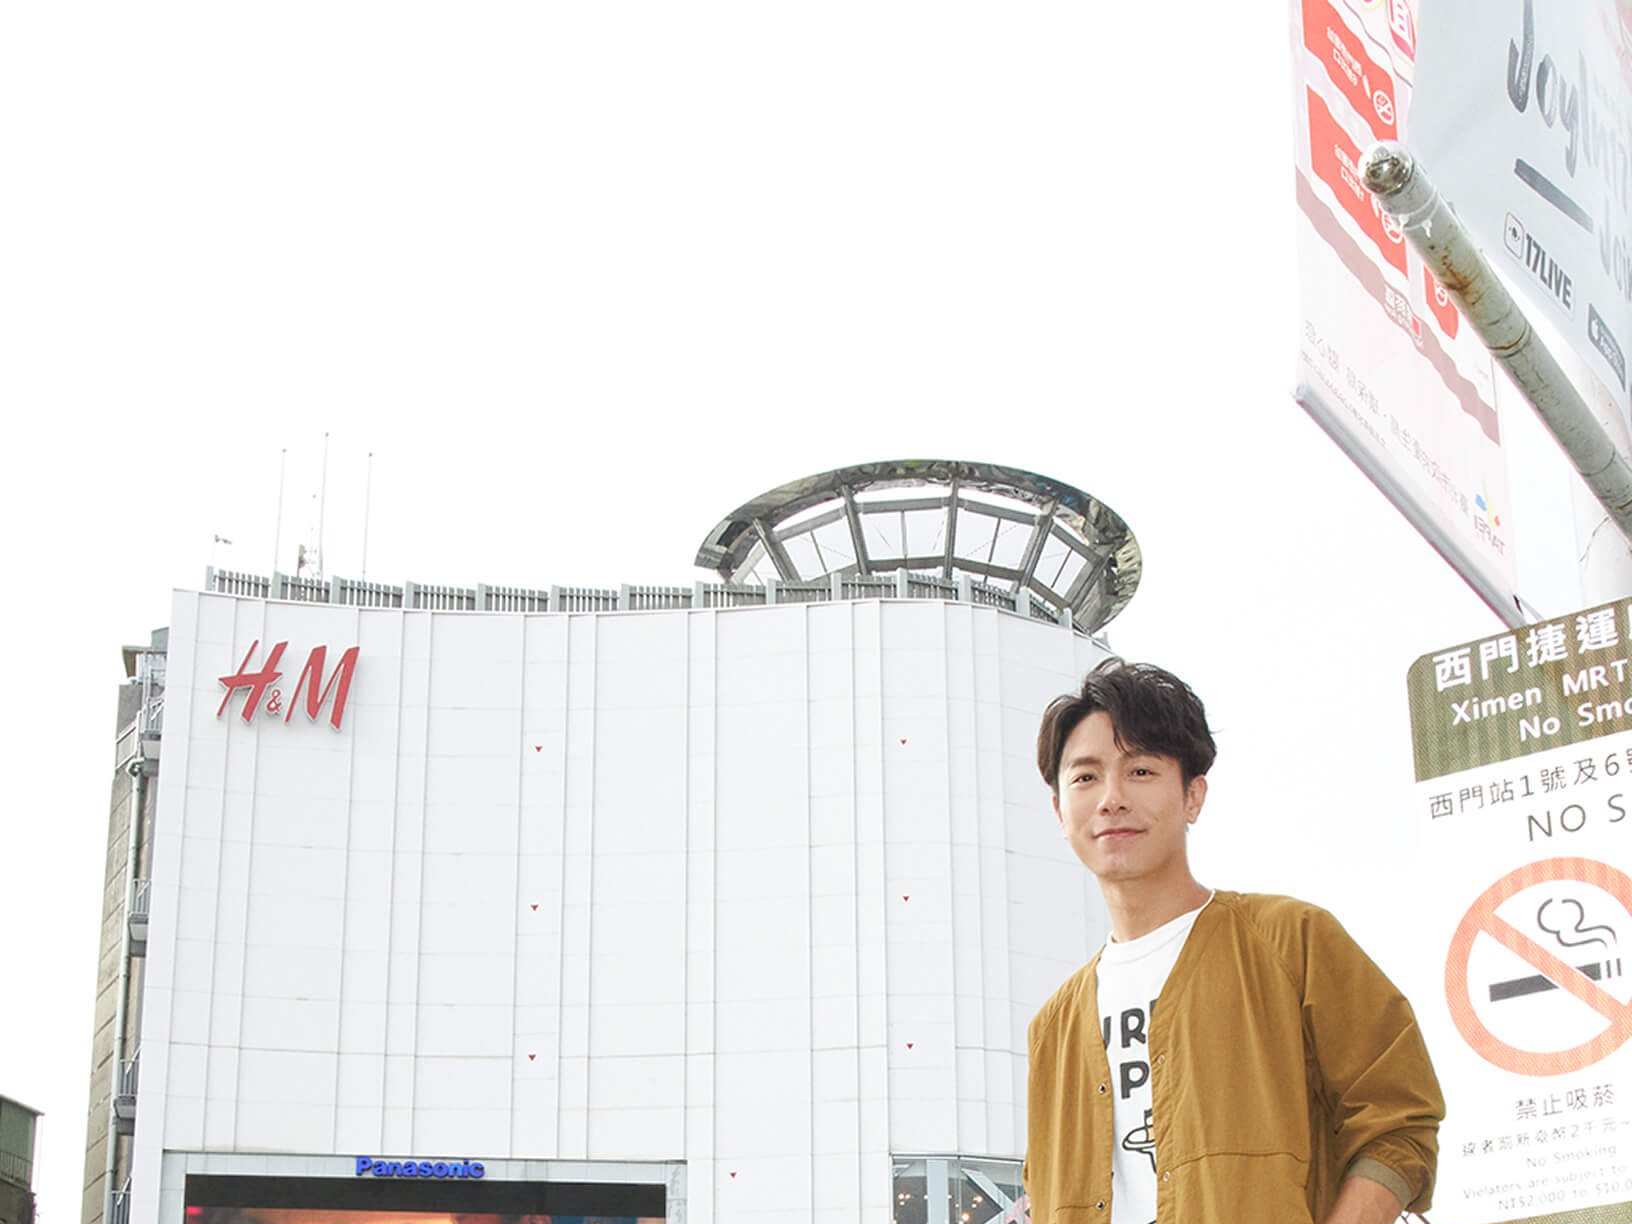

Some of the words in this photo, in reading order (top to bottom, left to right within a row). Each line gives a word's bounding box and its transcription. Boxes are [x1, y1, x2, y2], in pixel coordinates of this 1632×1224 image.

[1432, 604, 1632, 692] 西門捷運
[217, 640, 360, 729] H&M
[1451, 687, 1543, 726] Ximen
[1562, 658, 1628, 697] MRT
[1519, 715, 1561, 742] No
[1429, 747, 1632, 819] 西門站1號及6
[1528, 804, 1587, 842] NO
[1515, 1084, 1615, 1120] 禁止吸菸
[356, 1157, 485, 1179] Panasonic
